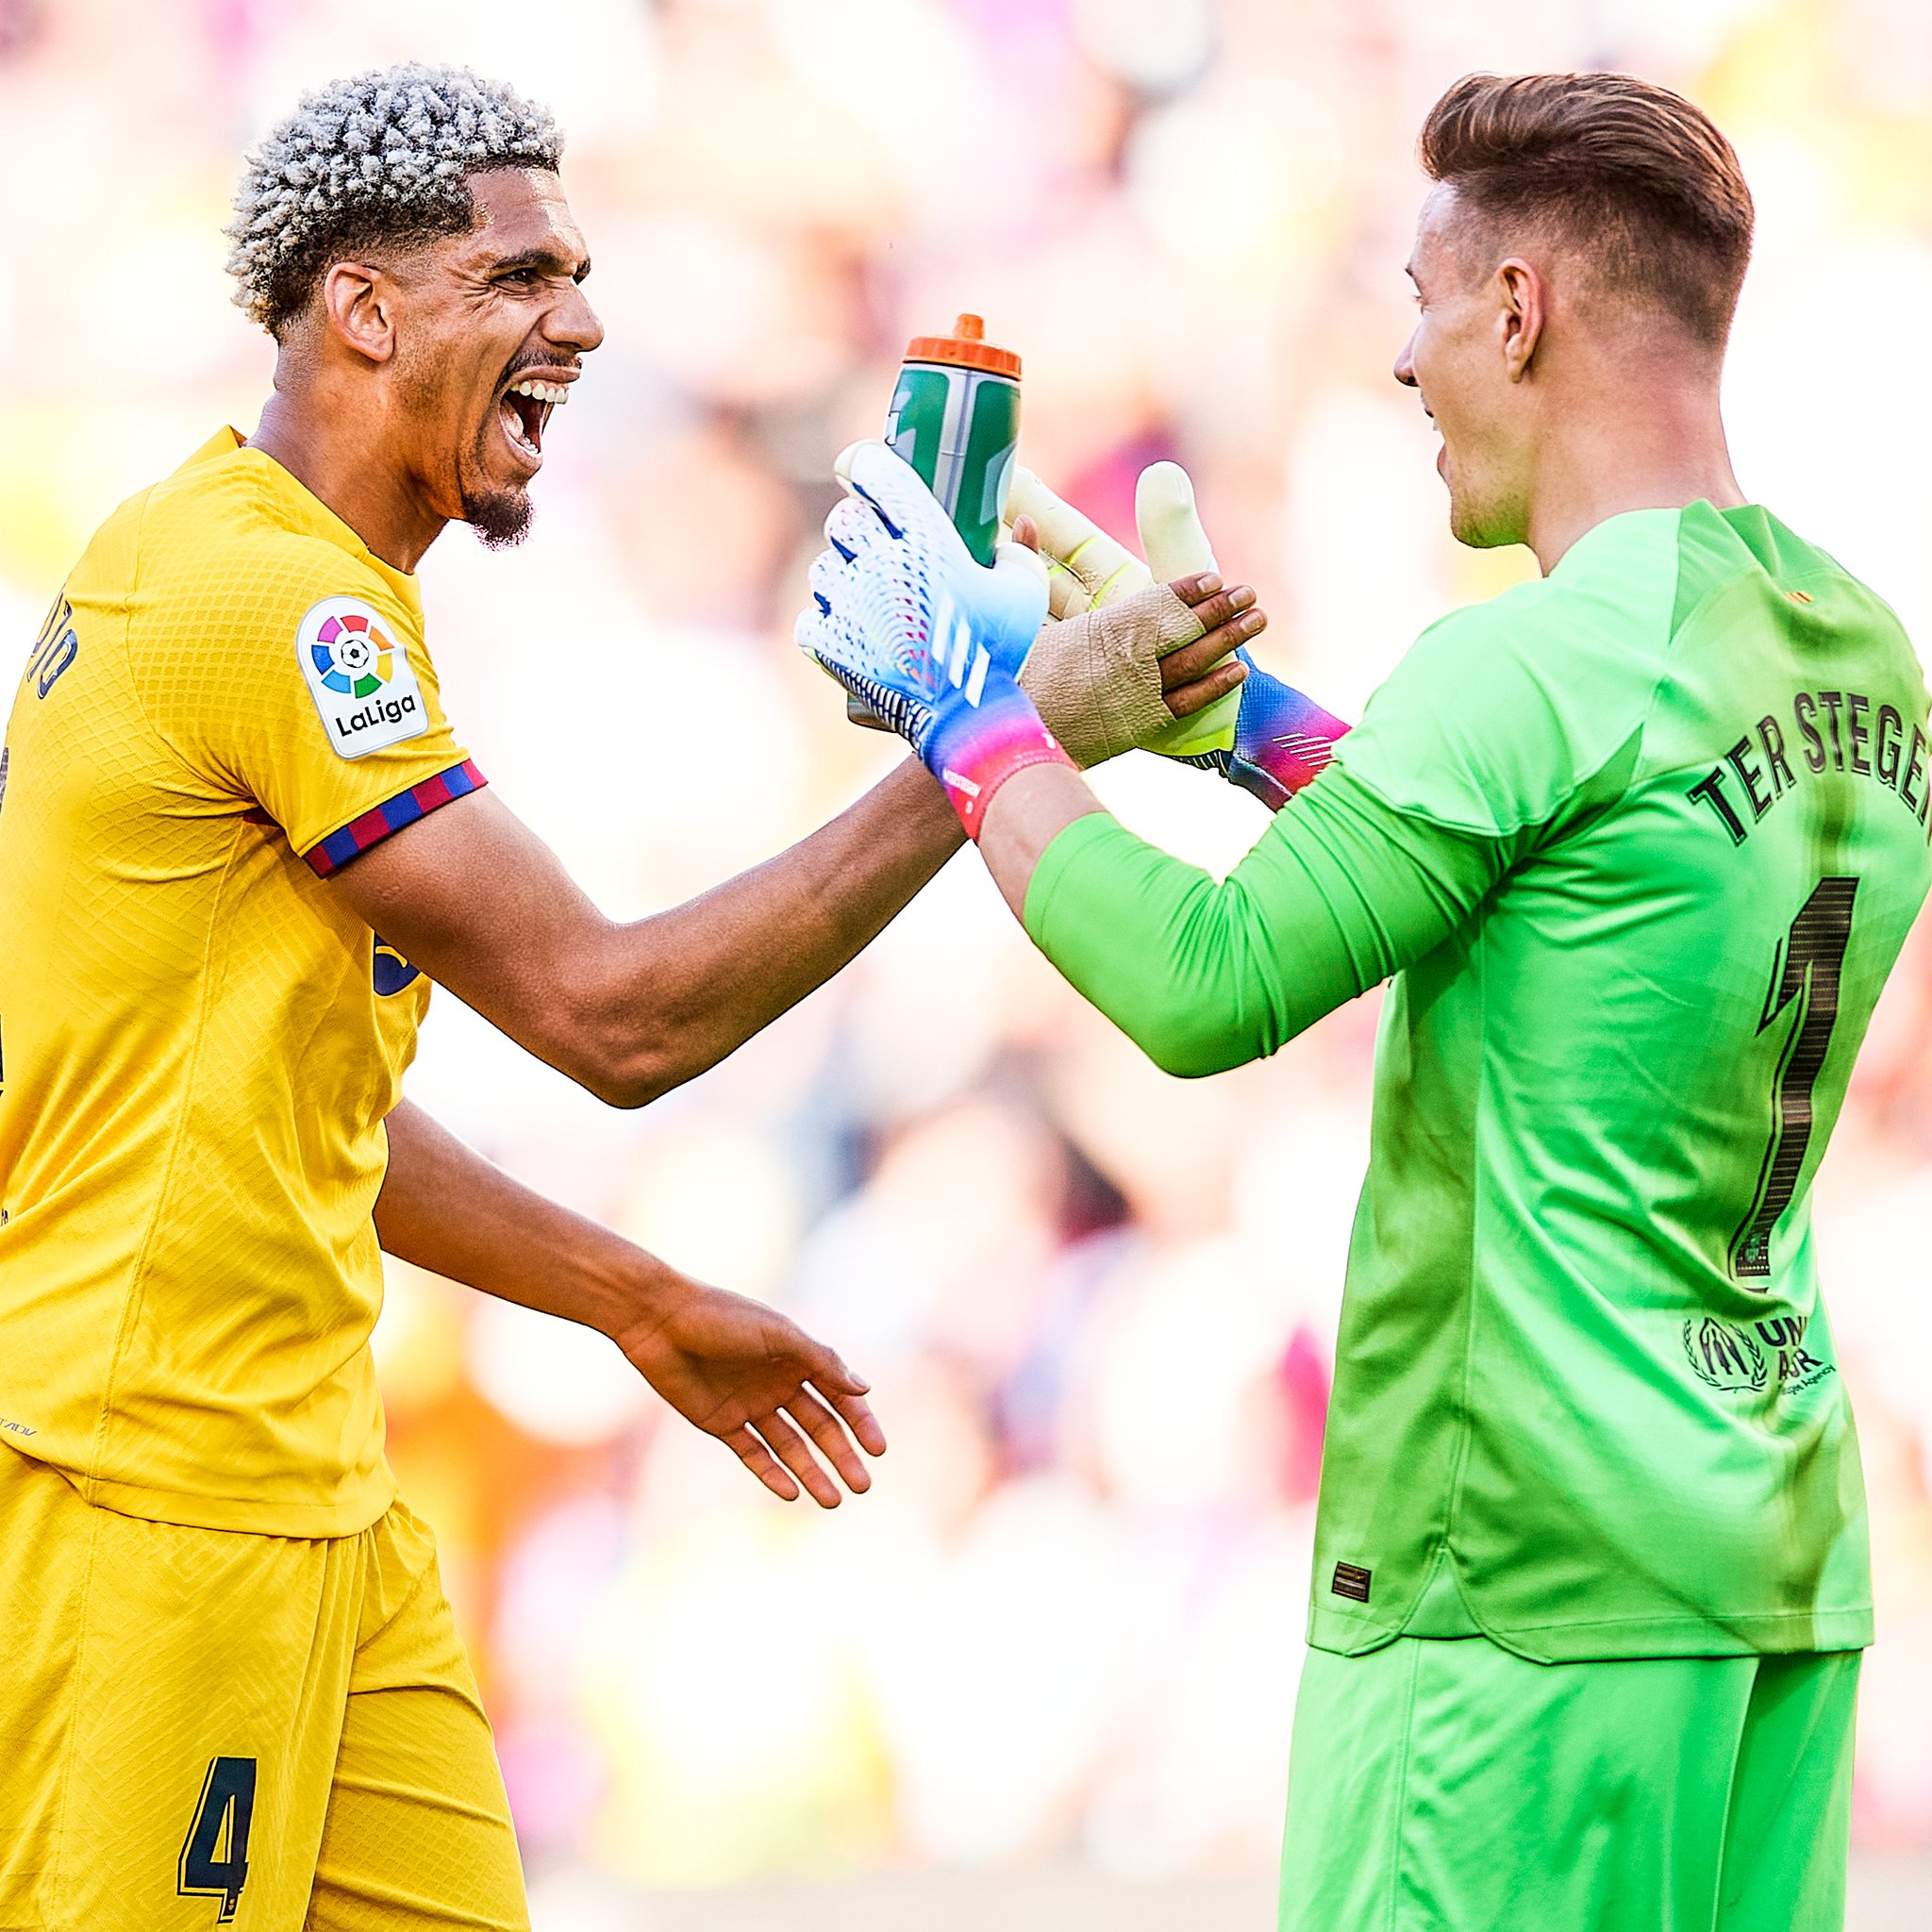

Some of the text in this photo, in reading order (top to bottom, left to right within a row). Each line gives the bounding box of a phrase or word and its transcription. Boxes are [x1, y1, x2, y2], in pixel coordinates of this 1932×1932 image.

[335, 695, 416, 737] LaLiga
[1686, 691, 1930, 846] TER STEGE
[1728, 876, 1859, 1293] 1
[177, 1757, 257, 1924] 4
